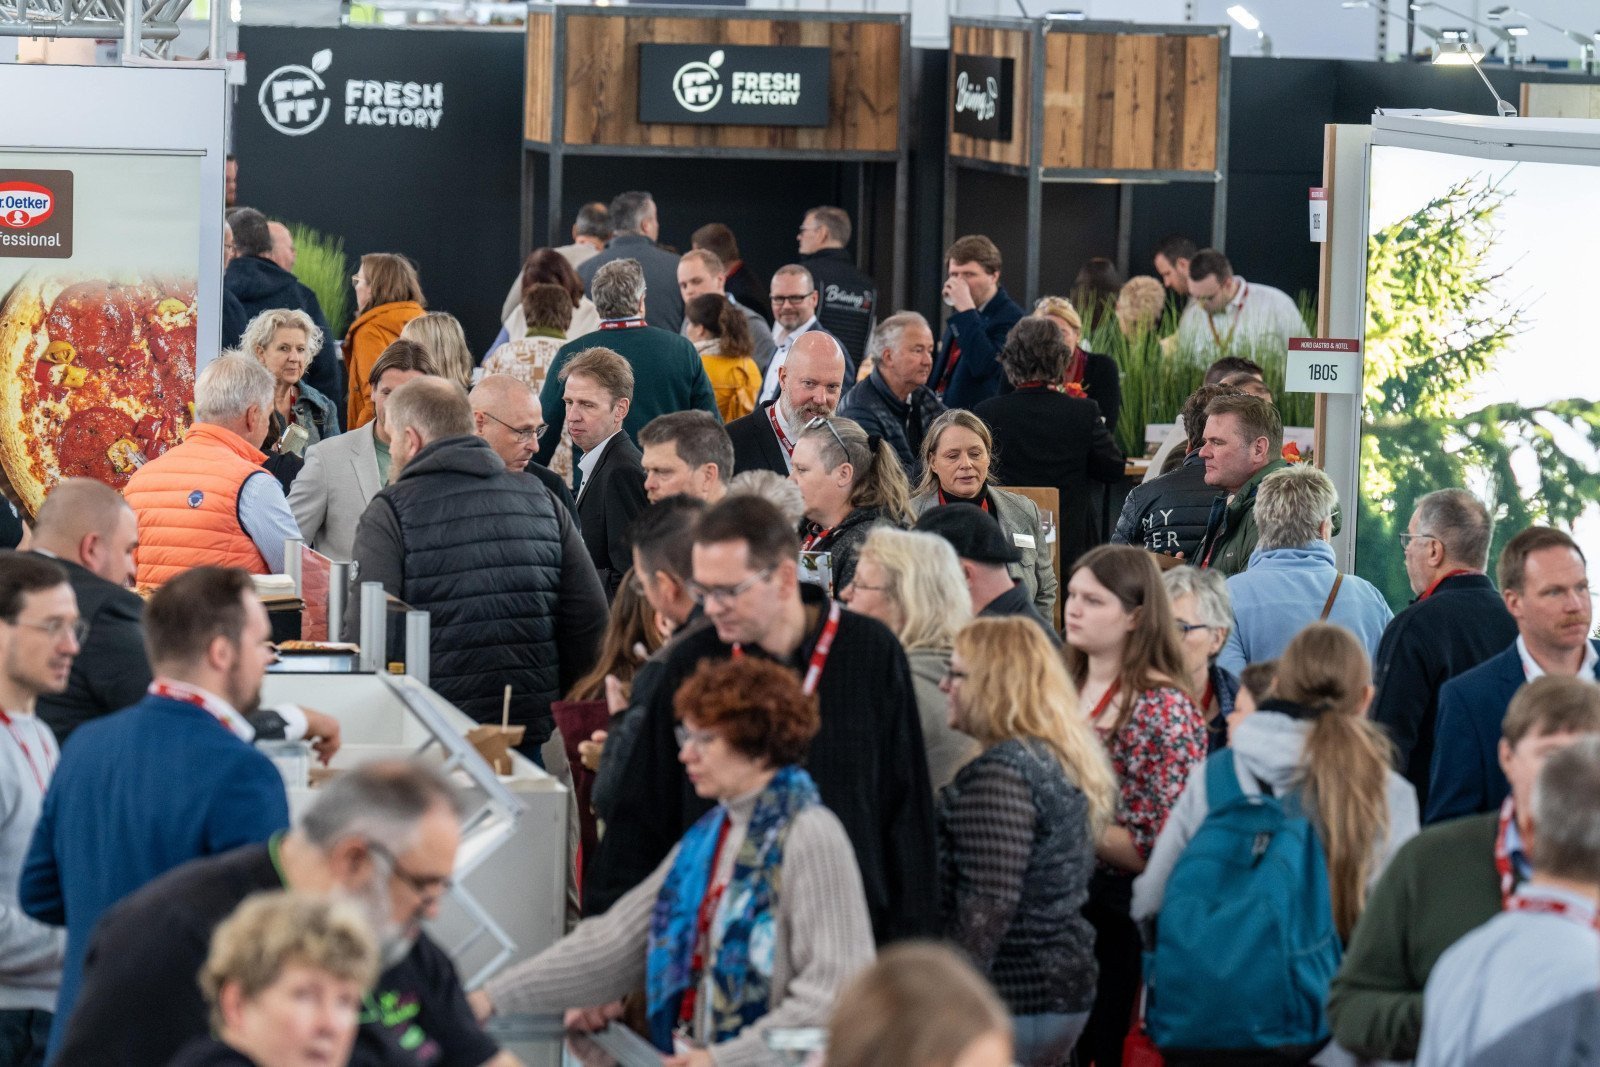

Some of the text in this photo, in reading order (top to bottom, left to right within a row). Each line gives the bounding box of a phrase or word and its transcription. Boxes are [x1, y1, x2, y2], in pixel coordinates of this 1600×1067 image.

[732, 72, 801, 90] FRESH
[345, 79, 444, 109] FRESH
[731, 90, 801, 105] FACTORY
[344, 105, 444, 129] FACTORY
[1308, 364, 1338, 381] 1B05
